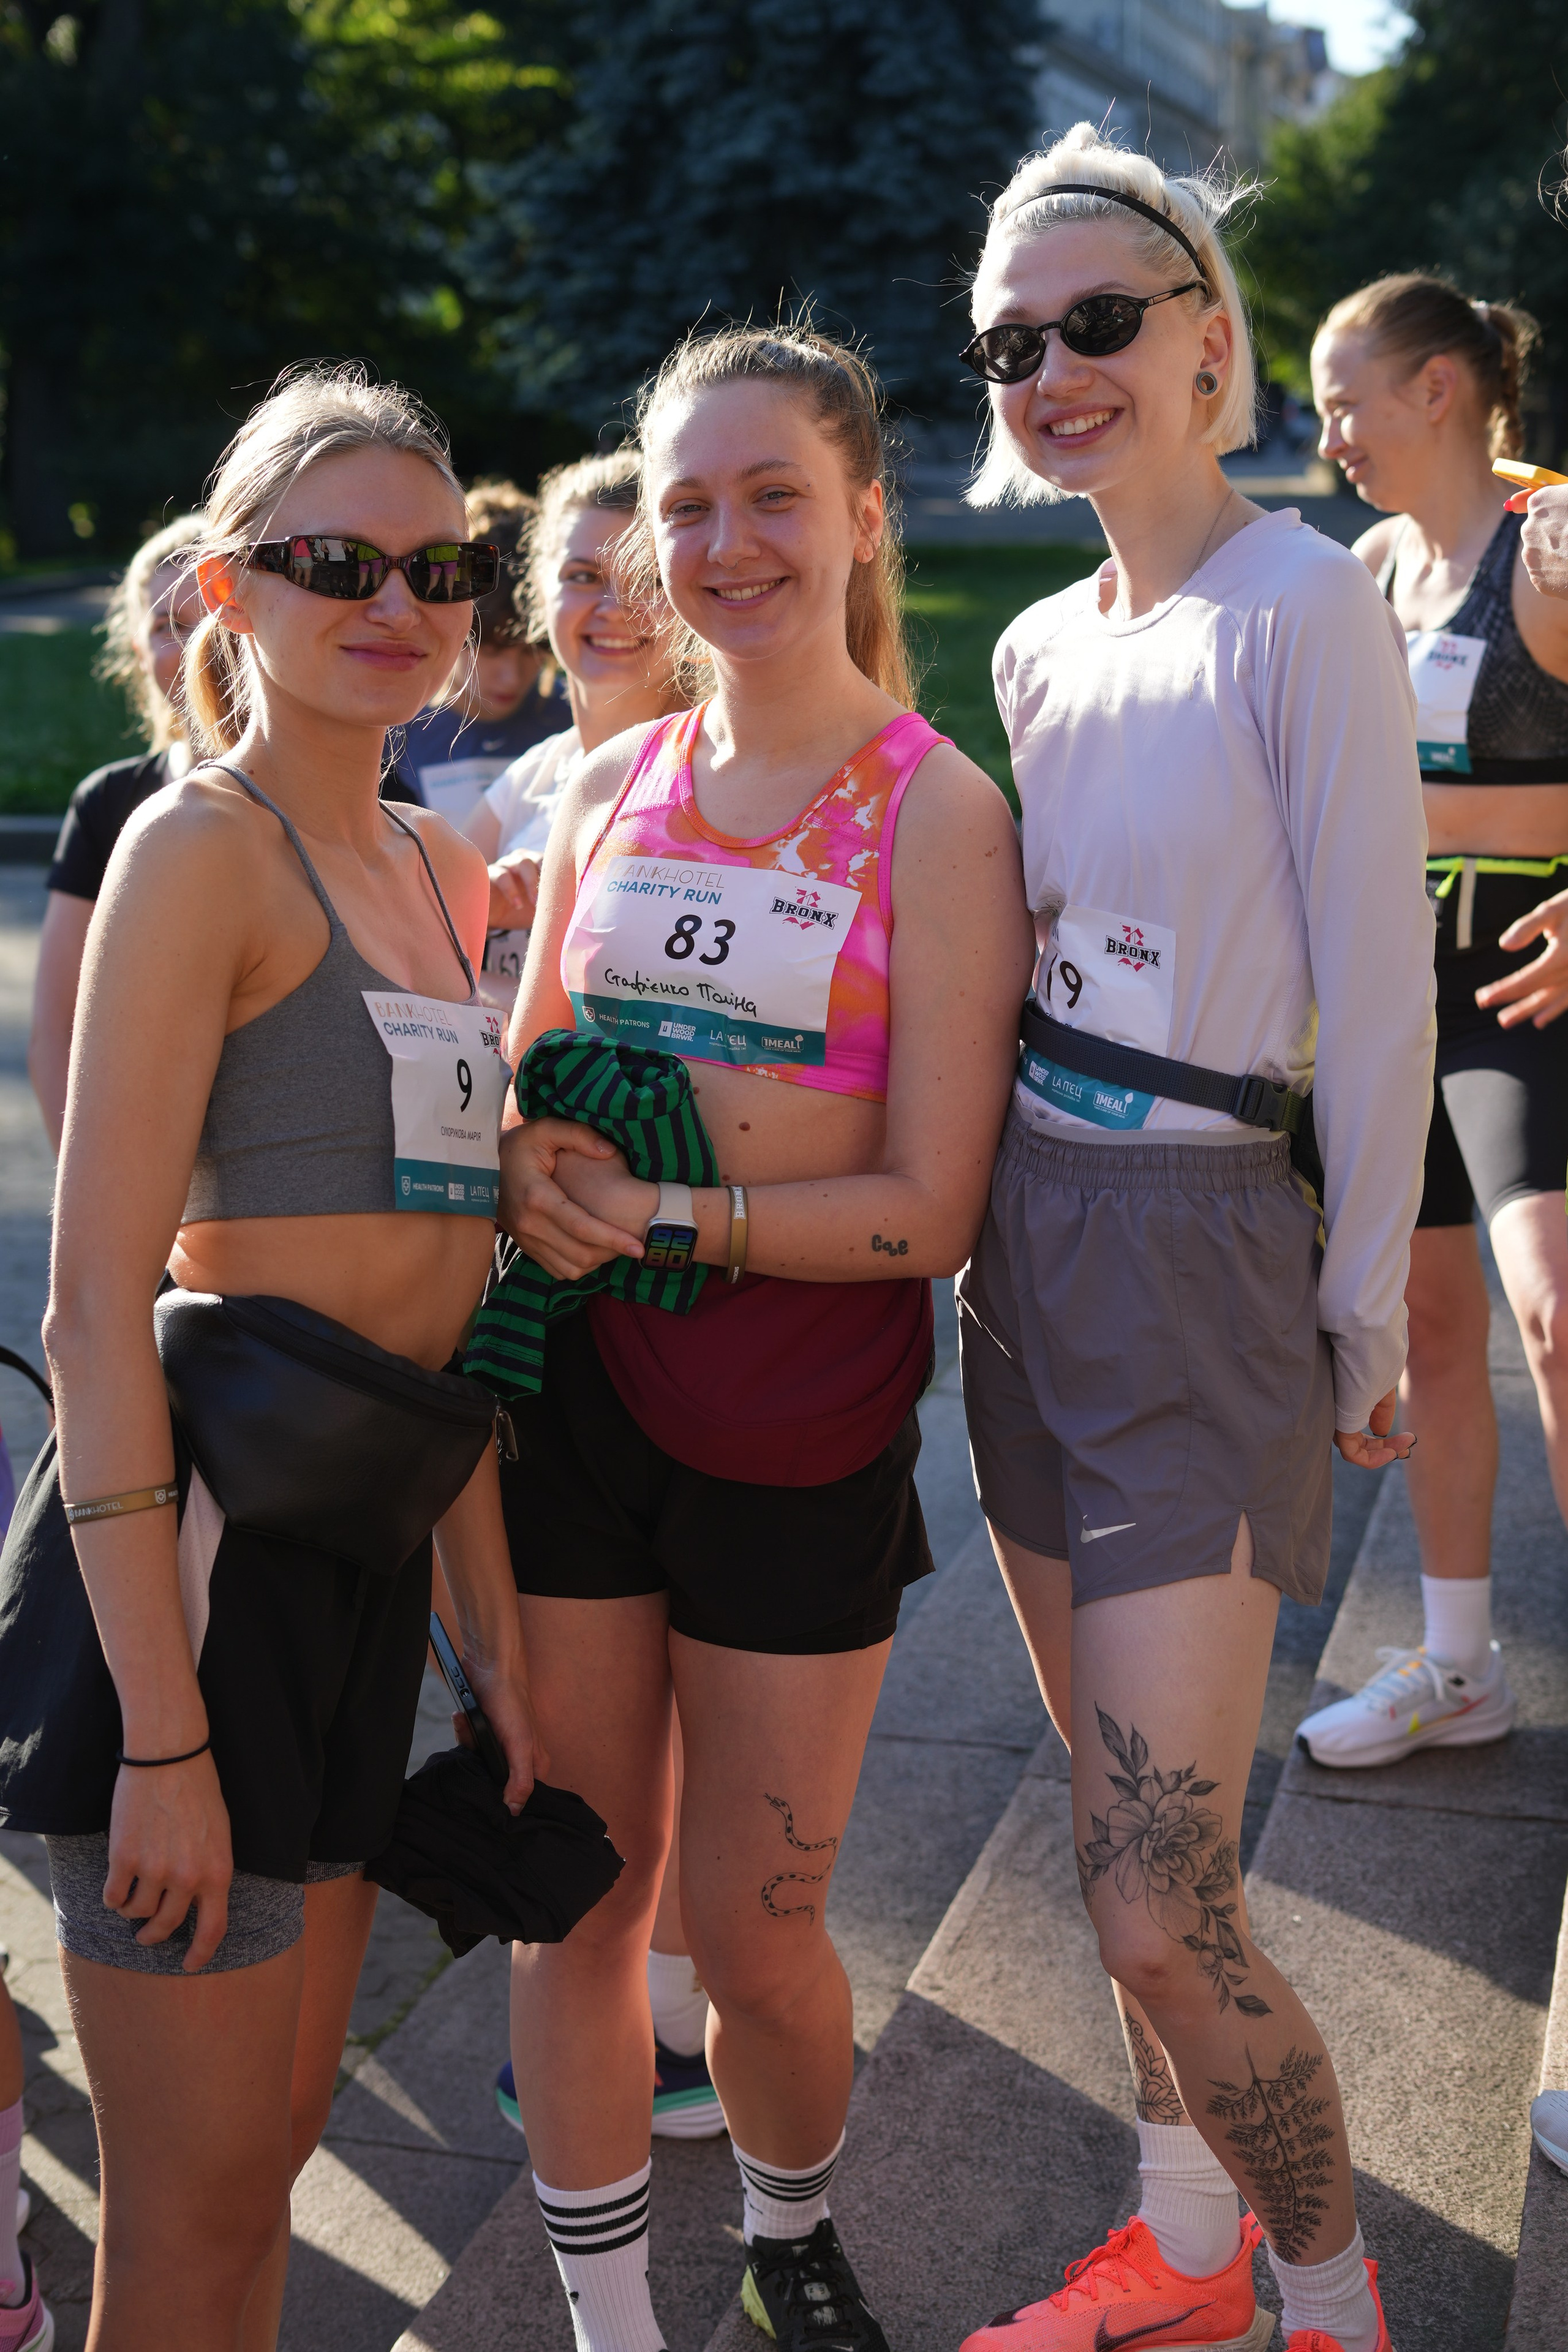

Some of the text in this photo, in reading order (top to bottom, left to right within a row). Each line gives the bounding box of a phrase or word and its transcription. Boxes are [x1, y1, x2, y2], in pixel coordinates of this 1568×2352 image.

[606, 880, 722, 905] CHARITY RUN
[770, 897, 838, 929] BRONX
[665, 914, 736, 965] 83
[1105, 936, 1160, 968] BRONX
[374, 1001, 453, 1026] BANKHOTEL
[599, 1014, 650, 1029] HEALTH PATRONS
[673, 1022, 696, 1032] UNDER
[383, 1022, 459, 1044] CHARITY RUN
[671, 1033, 693, 1042] BRWR.
[673, 1027, 695, 1037] WOOD
[710, 1030, 723, 1041] LA
[1035, 1065, 1049, 1077] UNDER
[456, 1058, 472, 1112] 9
[1052, 1076, 1061, 1088] LA
[412, 1183, 444, 1193] HEALTH PATRONS
[470, 1185, 477, 1196] LA
